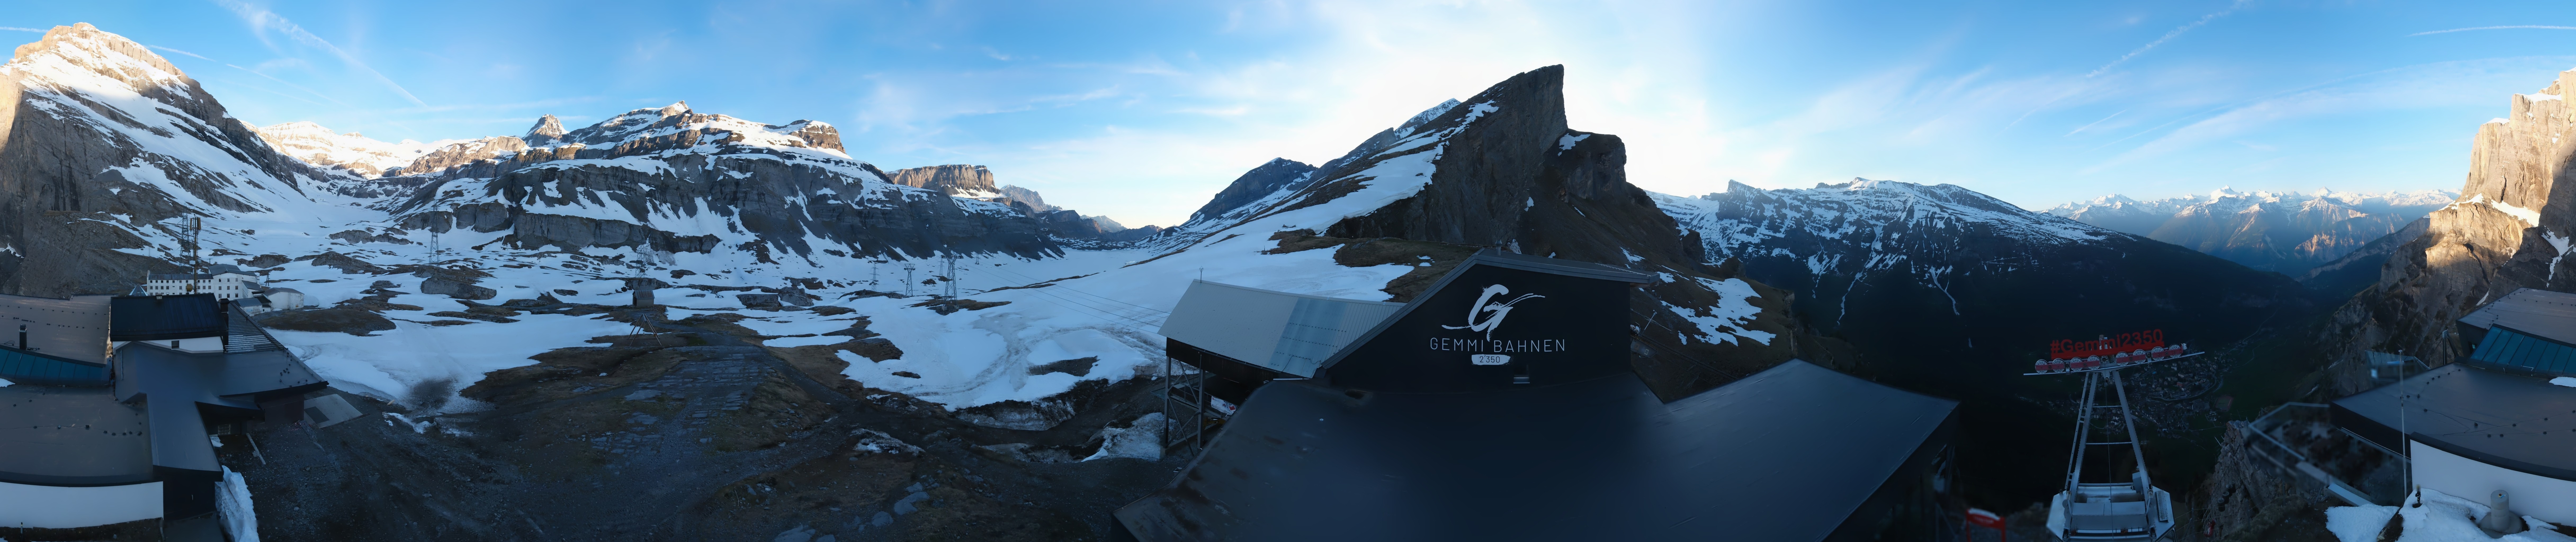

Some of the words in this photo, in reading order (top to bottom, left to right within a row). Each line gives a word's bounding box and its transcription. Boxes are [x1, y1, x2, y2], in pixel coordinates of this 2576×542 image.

[1430, 337, 1484, 352] GEMMI
[1494, 339, 1565, 352] BAHNEN
[2050, 329, 2163, 353] #Gemmi2350
